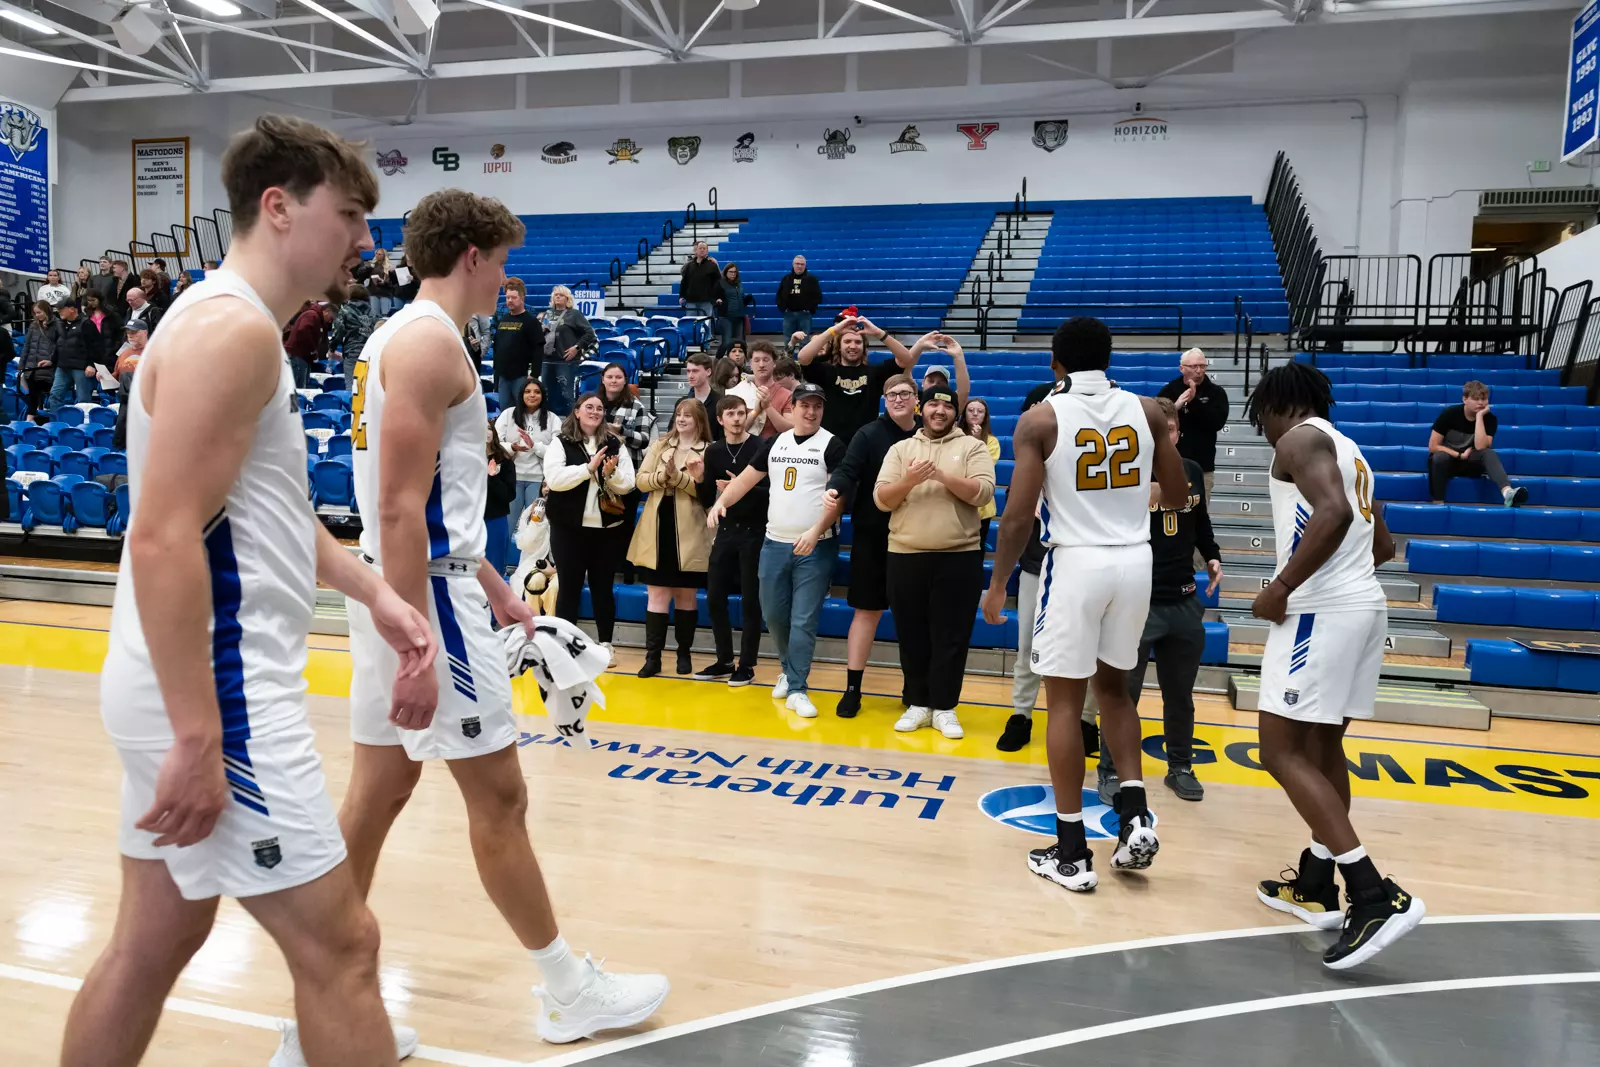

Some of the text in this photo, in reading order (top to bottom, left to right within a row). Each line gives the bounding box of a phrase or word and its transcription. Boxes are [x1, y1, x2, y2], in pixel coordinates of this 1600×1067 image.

[1576, 36, 1598, 64] GLVC
[1575, 55, 1596, 83] 1993
[1571, 88, 1595, 115] NCAA
[1571, 107, 1593, 133] 1993
[1114, 125, 1167, 136] HORIZON
[957, 123, 999, 150] Y
[137, 148, 184, 157] MASTODONS
[817, 145, 856, 155] CLEVELAND
[541, 154, 578, 165] MILWAUKEE
[484, 162, 512, 173] IUPUI
[574, 290, 600, 299] SECTION
[577, 301, 598, 316] 107
[771, 456, 819, 465] MASTODONS
[1075, 424, 1140, 491] 22
[784, 466, 797, 491] 0
[1235, 473, 1242, 481] E
[1241, 503, 1250, 511] D
[1251, 538, 1261, 547] C
[1261, 578, 1271, 589] B
[1385, 637, 1393, 649] A
[516, 730, 957, 792] Health Netwrk
[607, 763, 945, 820] Lutheran
